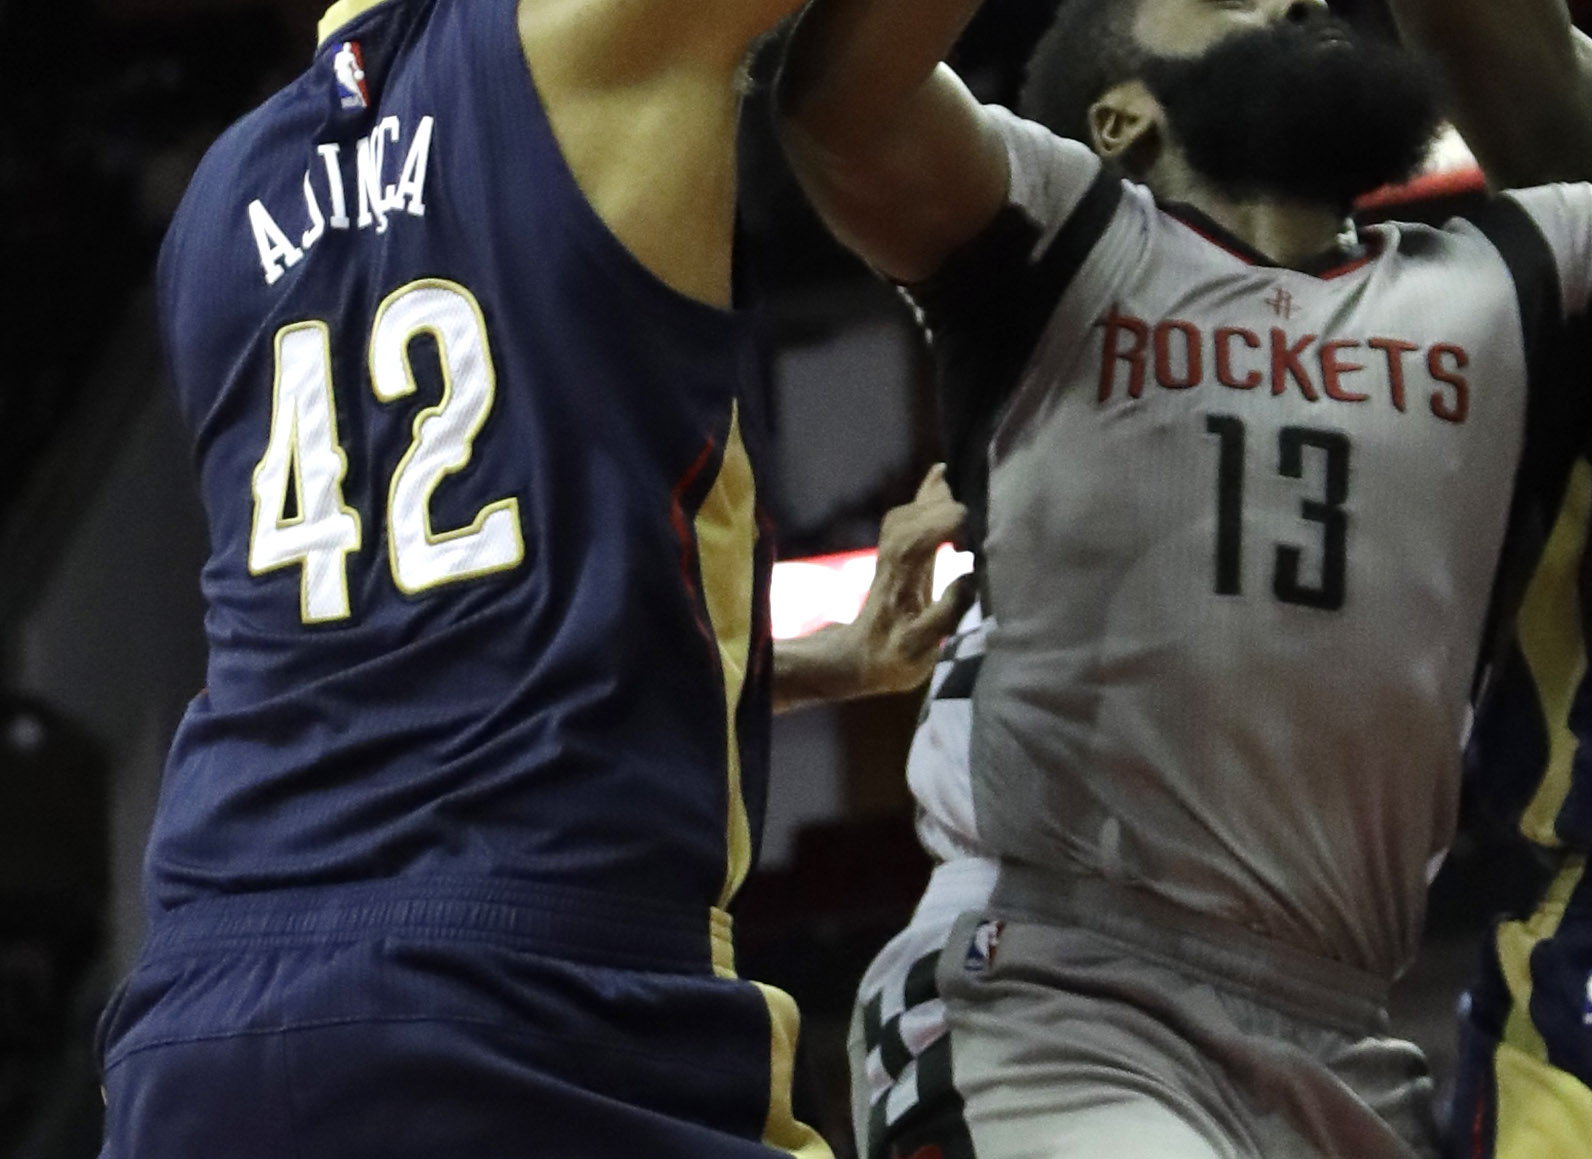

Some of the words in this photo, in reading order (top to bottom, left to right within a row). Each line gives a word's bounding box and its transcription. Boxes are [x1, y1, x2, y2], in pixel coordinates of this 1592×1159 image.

[248, 277, 526, 625] 42
[1095, 302, 1471, 424] ROCKETS
[1205, 412, 1352, 612] 13
